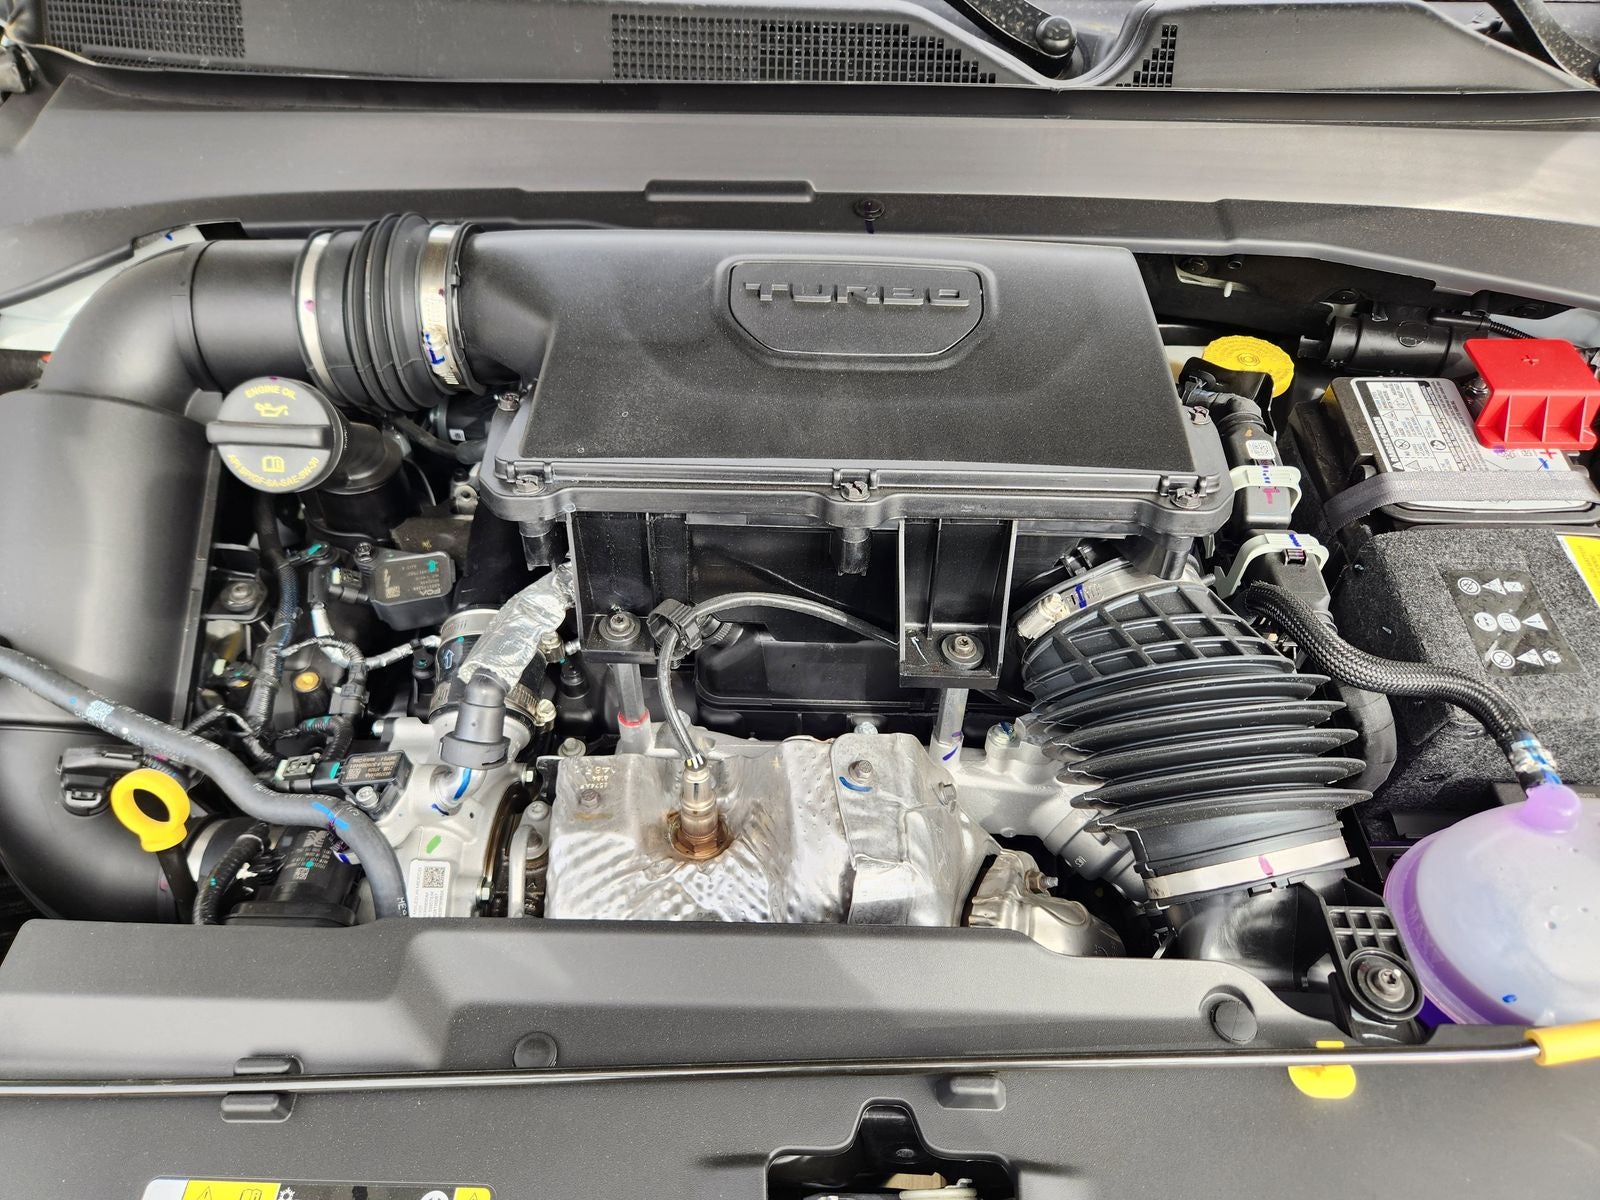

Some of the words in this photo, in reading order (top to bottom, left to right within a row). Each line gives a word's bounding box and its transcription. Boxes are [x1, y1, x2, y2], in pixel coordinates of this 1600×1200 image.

[743, 283, 970, 307] TURBO
[244, 384, 281, 399] ENGINE
[281, 387, 297, 400] OIL
[419, 587, 441, 596] FCA
